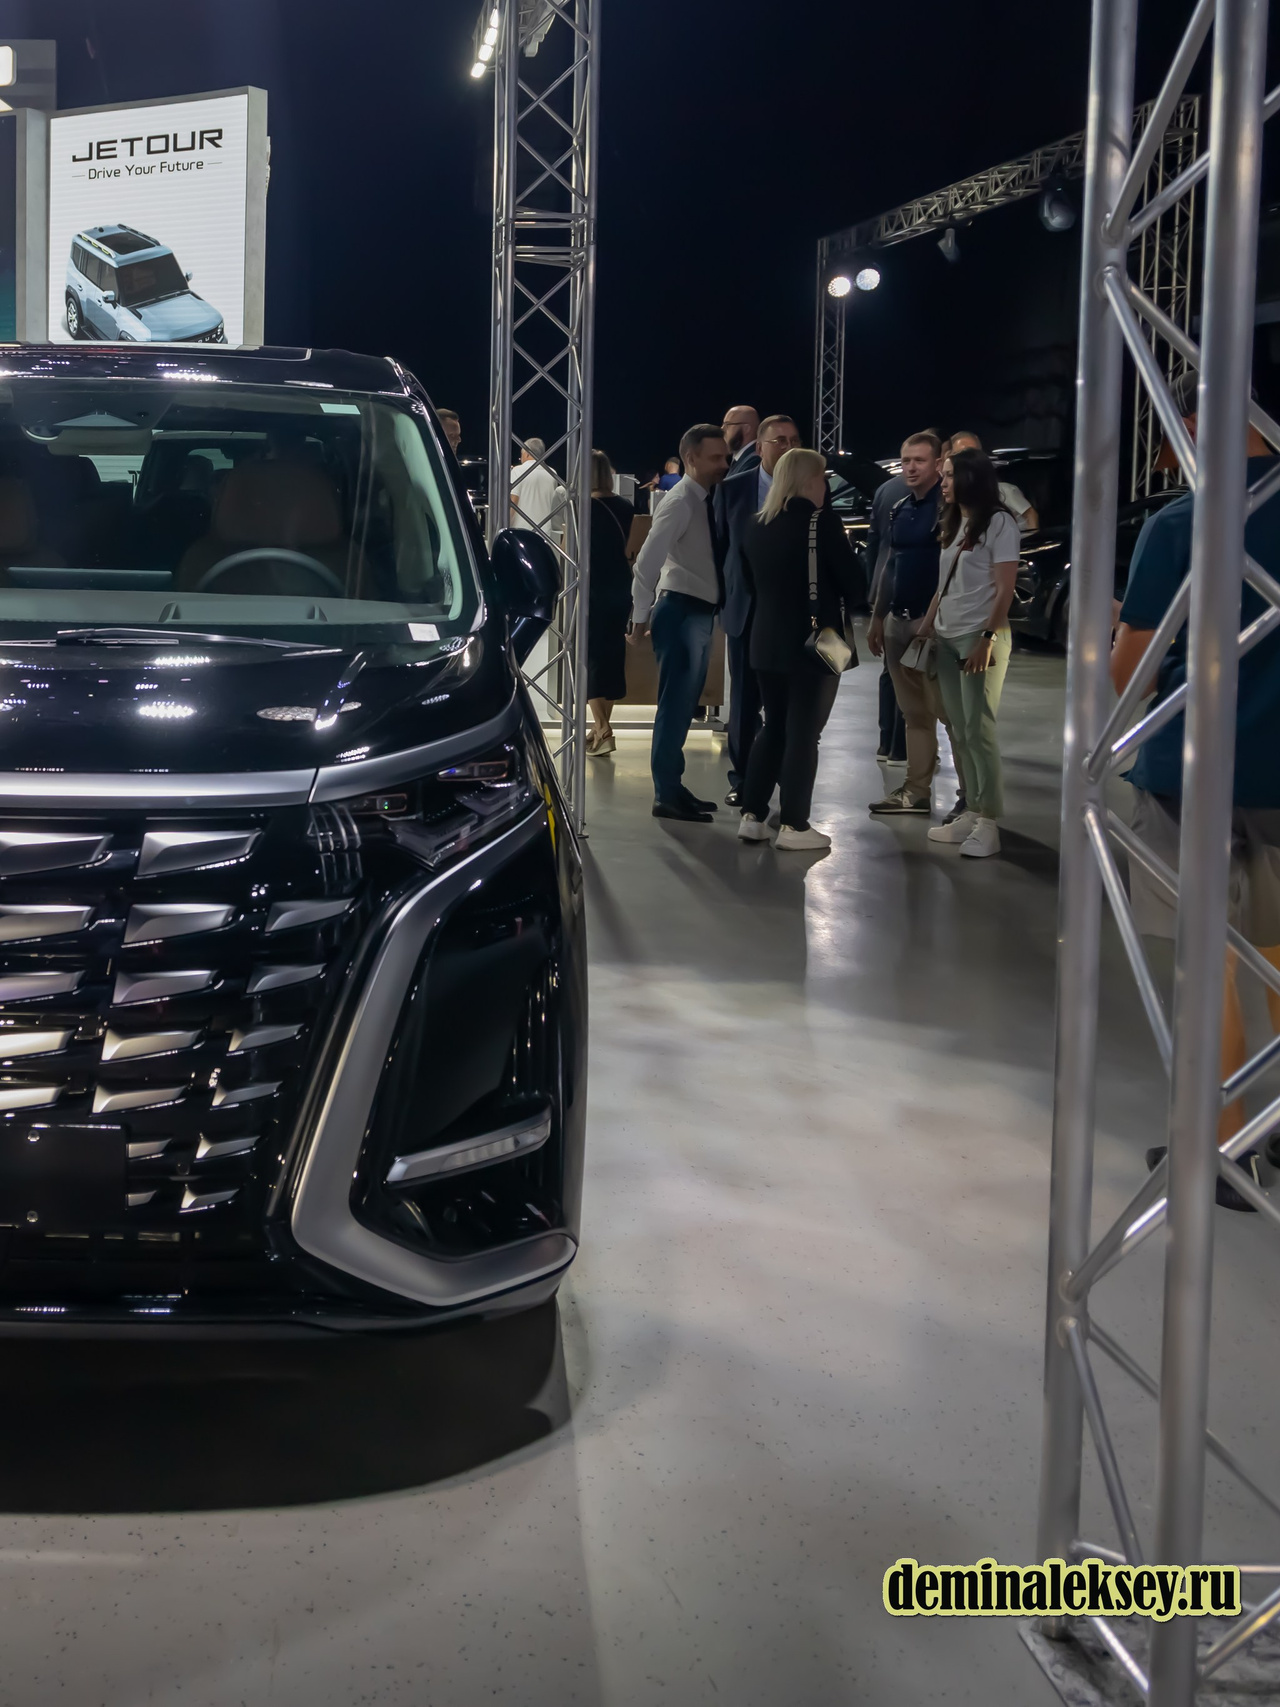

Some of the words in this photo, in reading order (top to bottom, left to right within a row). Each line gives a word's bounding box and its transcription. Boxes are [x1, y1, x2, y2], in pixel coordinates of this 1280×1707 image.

[72, 128, 223, 162] JETOUR
[88, 167, 121, 180] Drive
[125, 164, 156, 176] Your
[160, 160, 204, 173] Future
